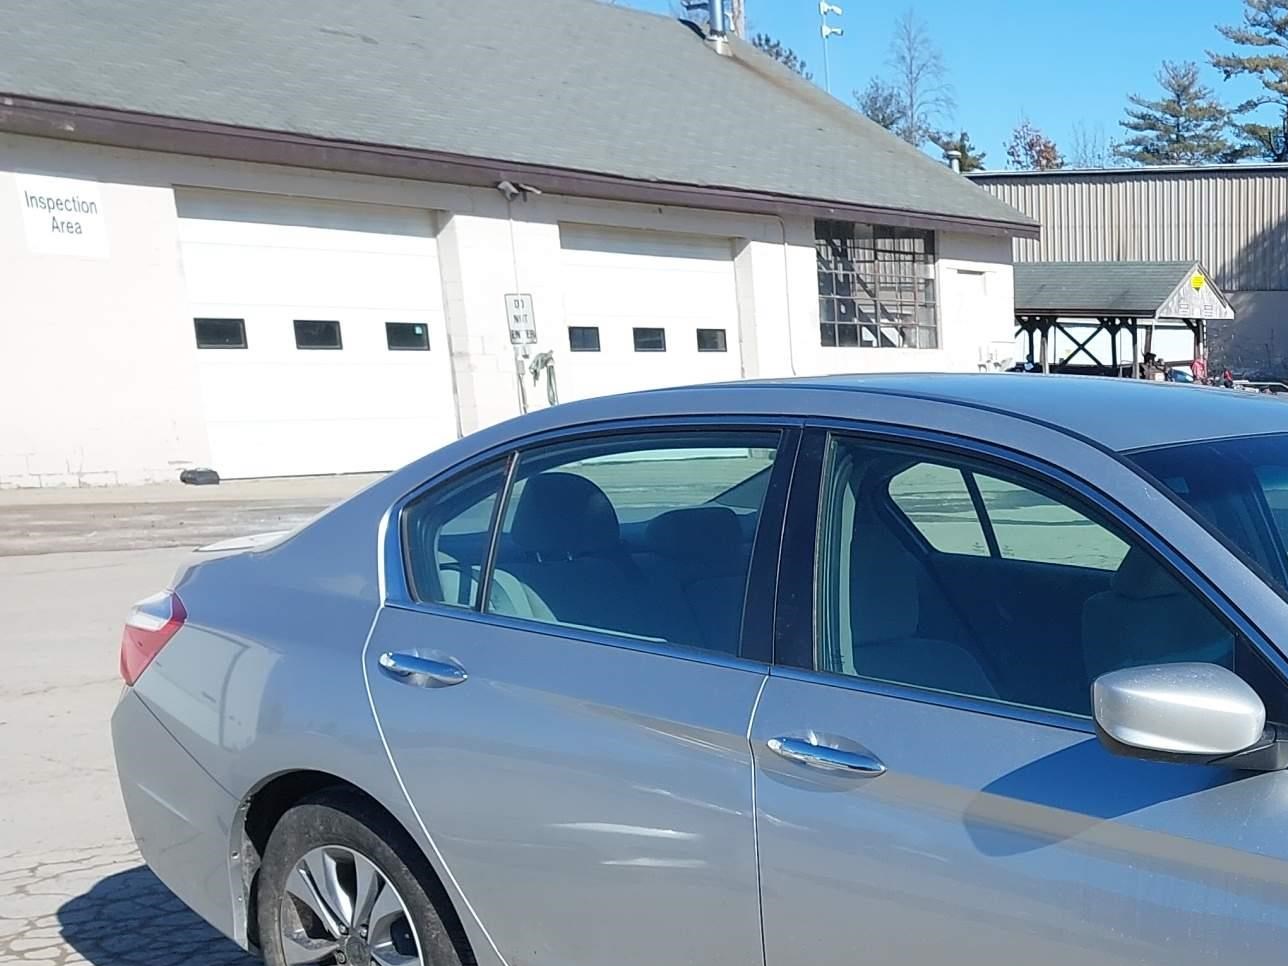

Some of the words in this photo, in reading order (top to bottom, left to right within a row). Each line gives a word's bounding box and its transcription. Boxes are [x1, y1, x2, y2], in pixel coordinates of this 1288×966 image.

[24, 190, 98, 214] Inspection
[51, 215, 83, 235] Area
[511, 329, 537, 340] ENER
